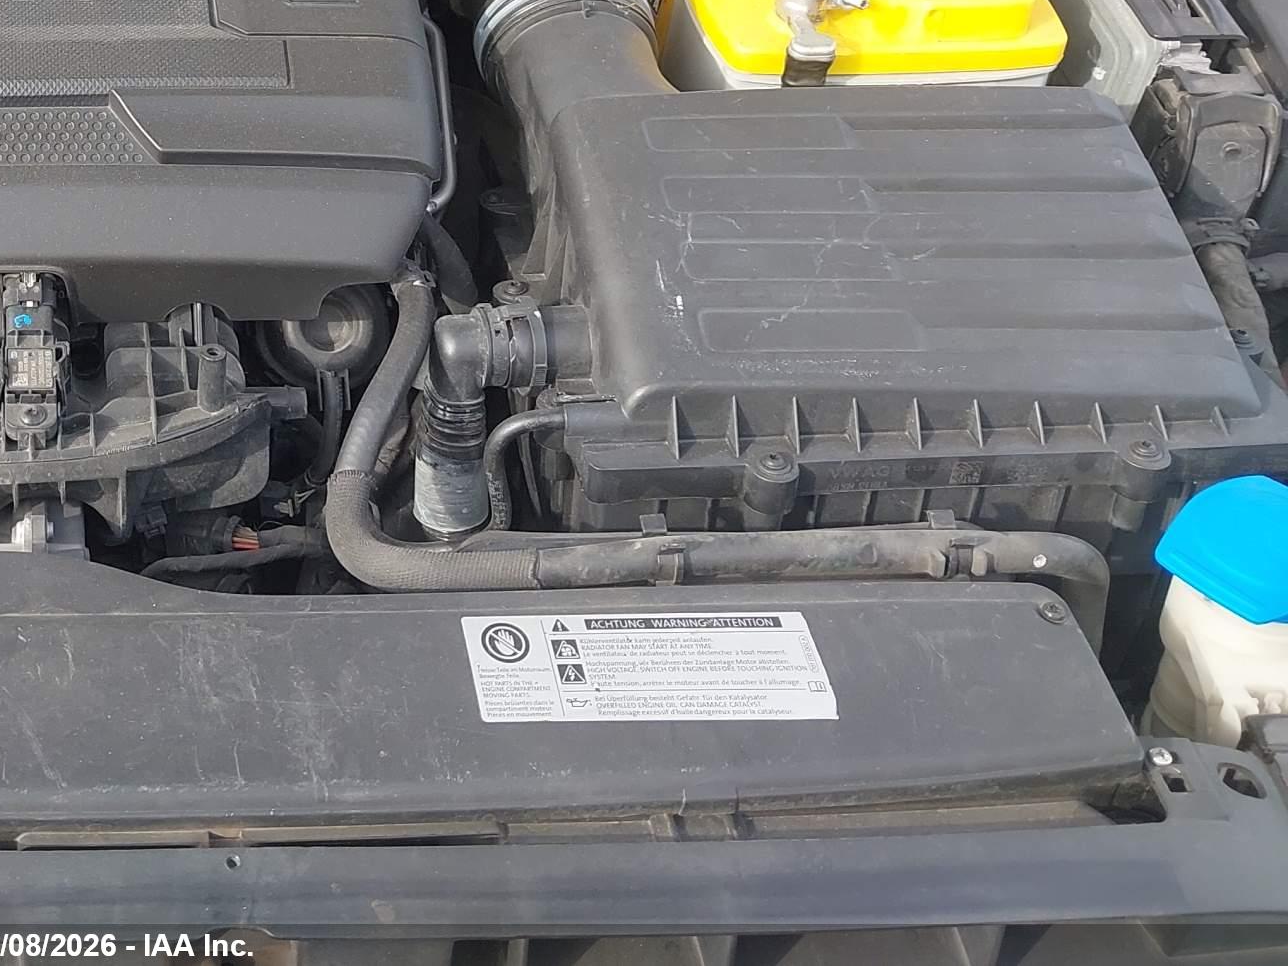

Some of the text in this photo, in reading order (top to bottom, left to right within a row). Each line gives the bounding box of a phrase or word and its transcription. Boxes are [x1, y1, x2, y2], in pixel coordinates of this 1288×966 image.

[590, 617, 774, 629] ACHTUNG WARNING ATTENTION
